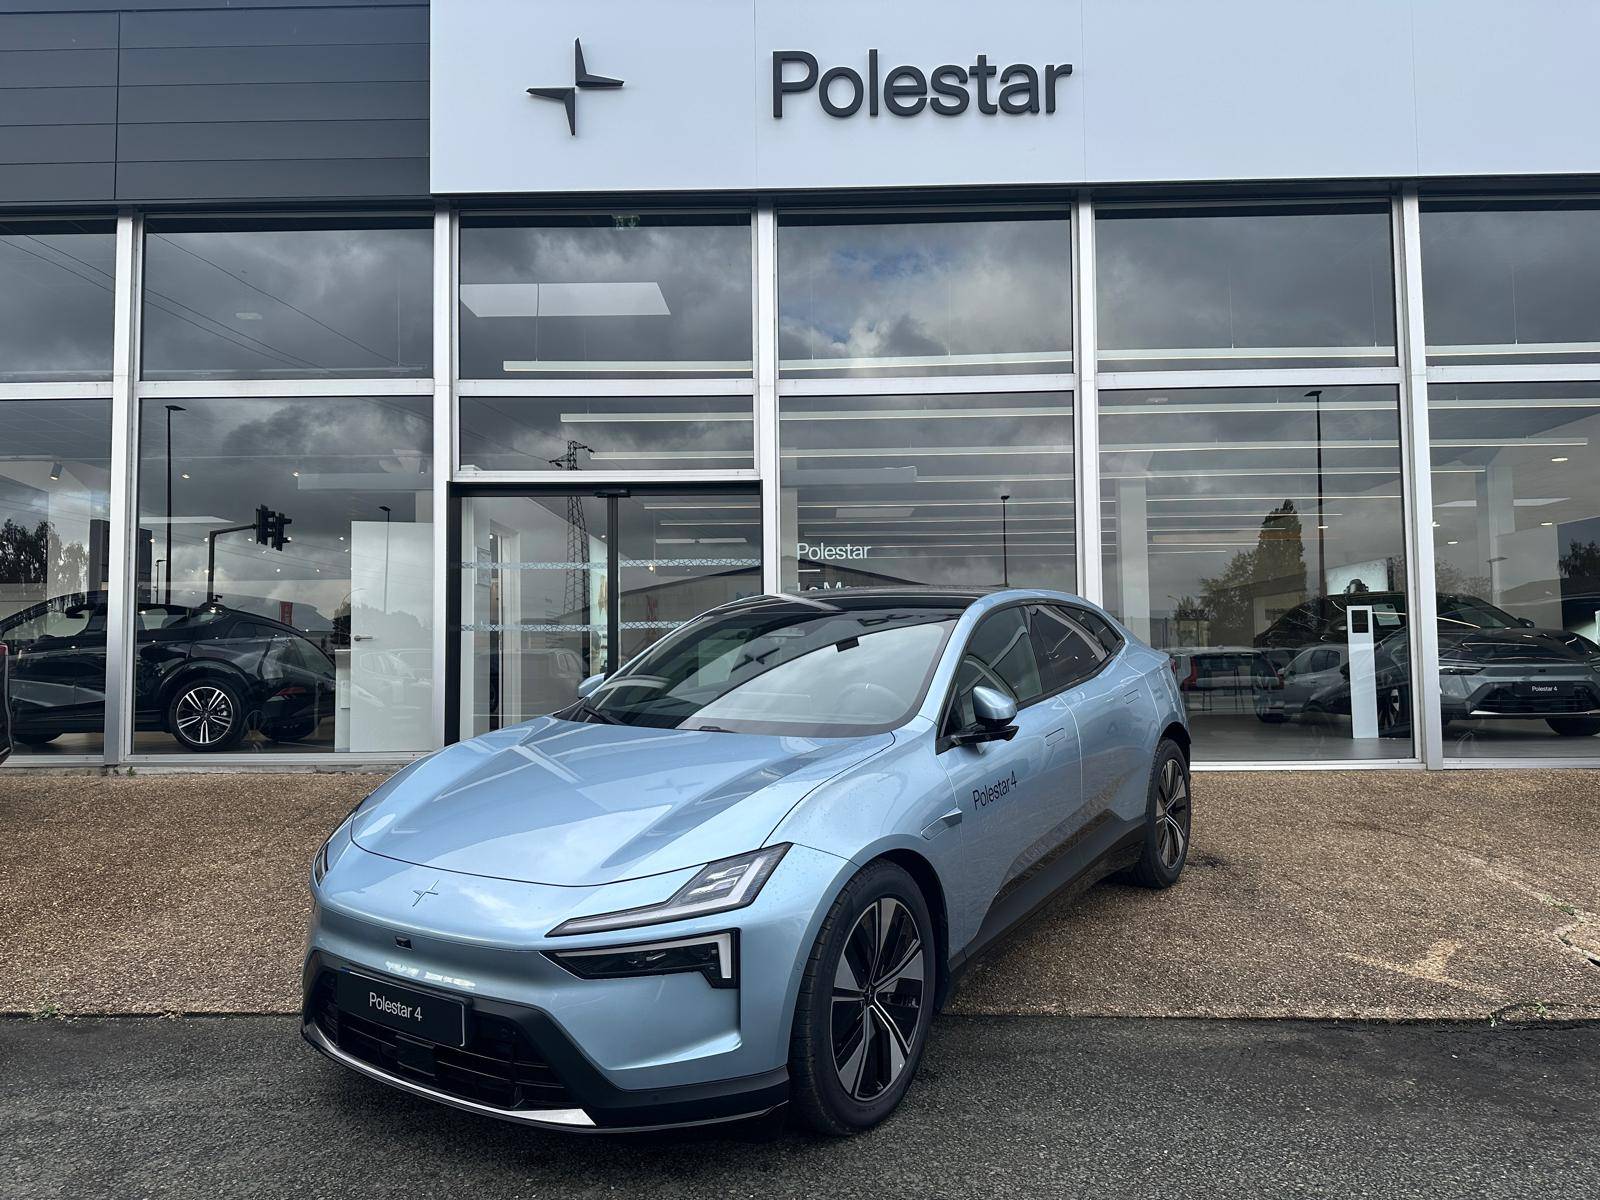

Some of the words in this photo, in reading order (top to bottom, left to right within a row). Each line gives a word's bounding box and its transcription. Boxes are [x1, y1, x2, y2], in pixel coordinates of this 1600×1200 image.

[772, 49, 1073, 118] Polestar
[796, 542, 872, 560] Polestar
[972, 777, 1010, 810] Polestar
[1010, 769, 1018, 789] 4
[369, 992, 413, 1019] Polestar
[414, 1006, 423, 1022] 4
